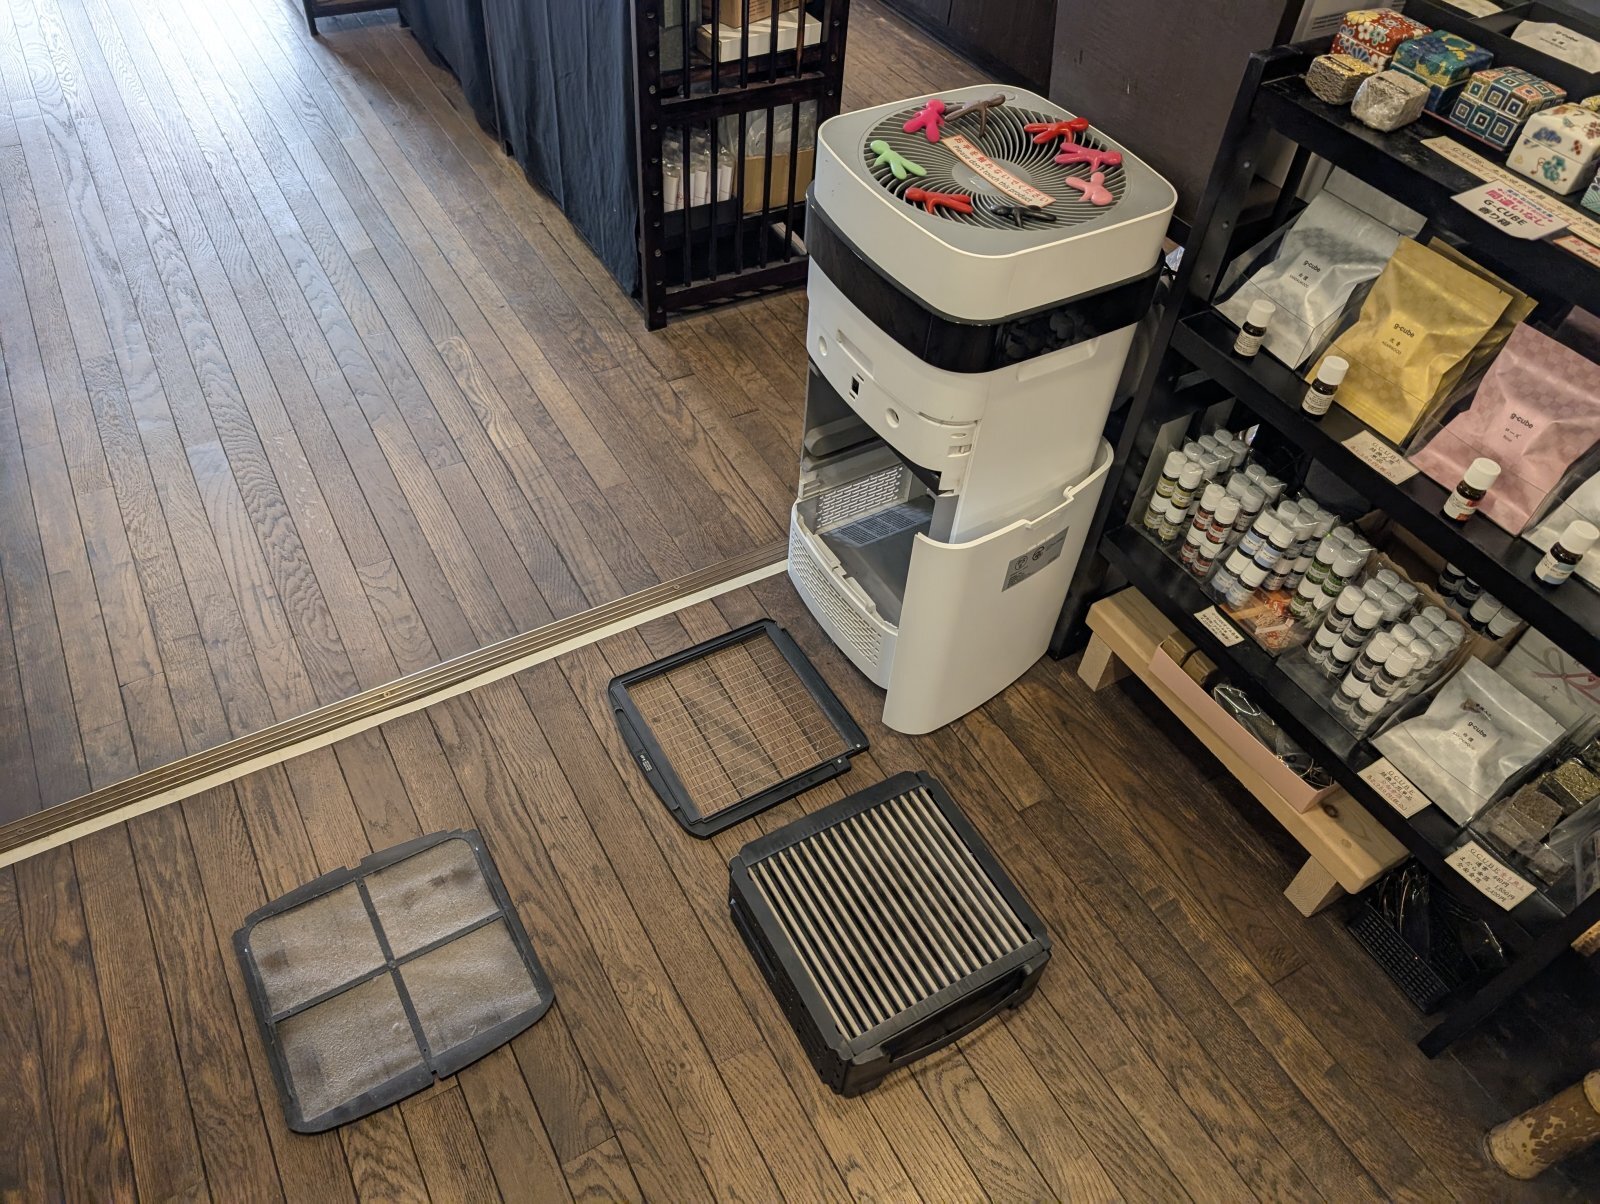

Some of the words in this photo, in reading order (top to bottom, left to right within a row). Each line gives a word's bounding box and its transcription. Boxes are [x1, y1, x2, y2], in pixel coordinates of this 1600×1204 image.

[952, 145, 971, 160] Please
[969, 158, 985, 172] don't
[983, 170, 1000, 184] touch
[998, 180, 1011, 191] this
[1008, 187, 1033, 203] product
[1484, 199, 1528, 226] G-CUBE
[1485, 190, 1545, 227] 間違いなし
